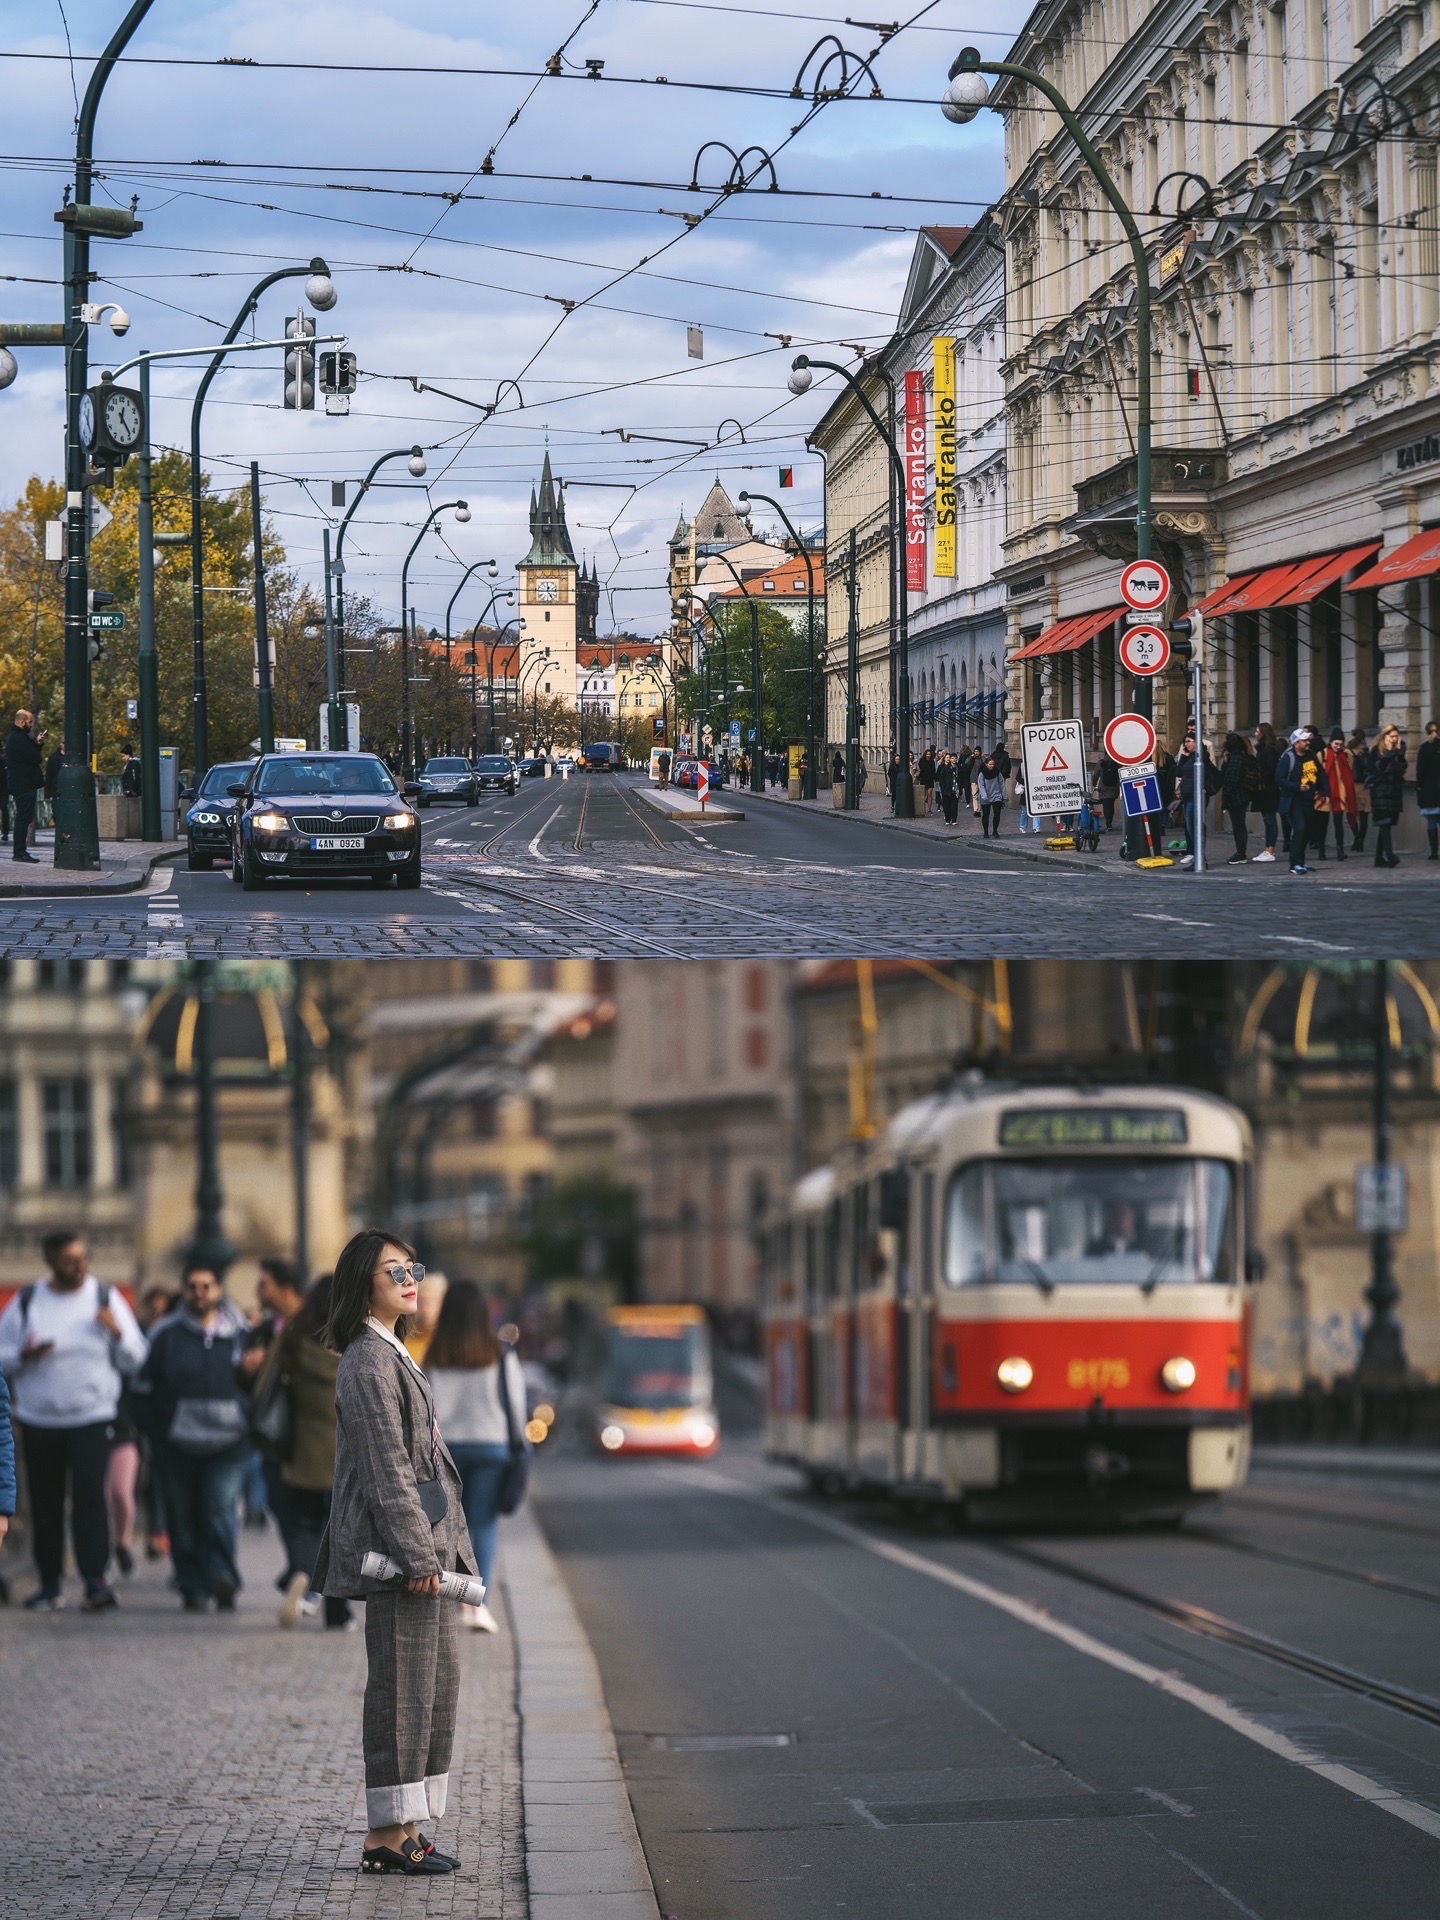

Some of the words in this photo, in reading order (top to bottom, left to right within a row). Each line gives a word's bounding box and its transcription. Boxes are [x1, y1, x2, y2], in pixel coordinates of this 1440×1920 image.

[935, 398, 955, 526] Safranko
[102, 616, 113, 626] WC
[1028, 727, 1076, 742] POZOR
[1127, 768, 1139, 776] 300
[318, 840, 334, 848] 4AN
[340, 840, 361, 848] 0926
